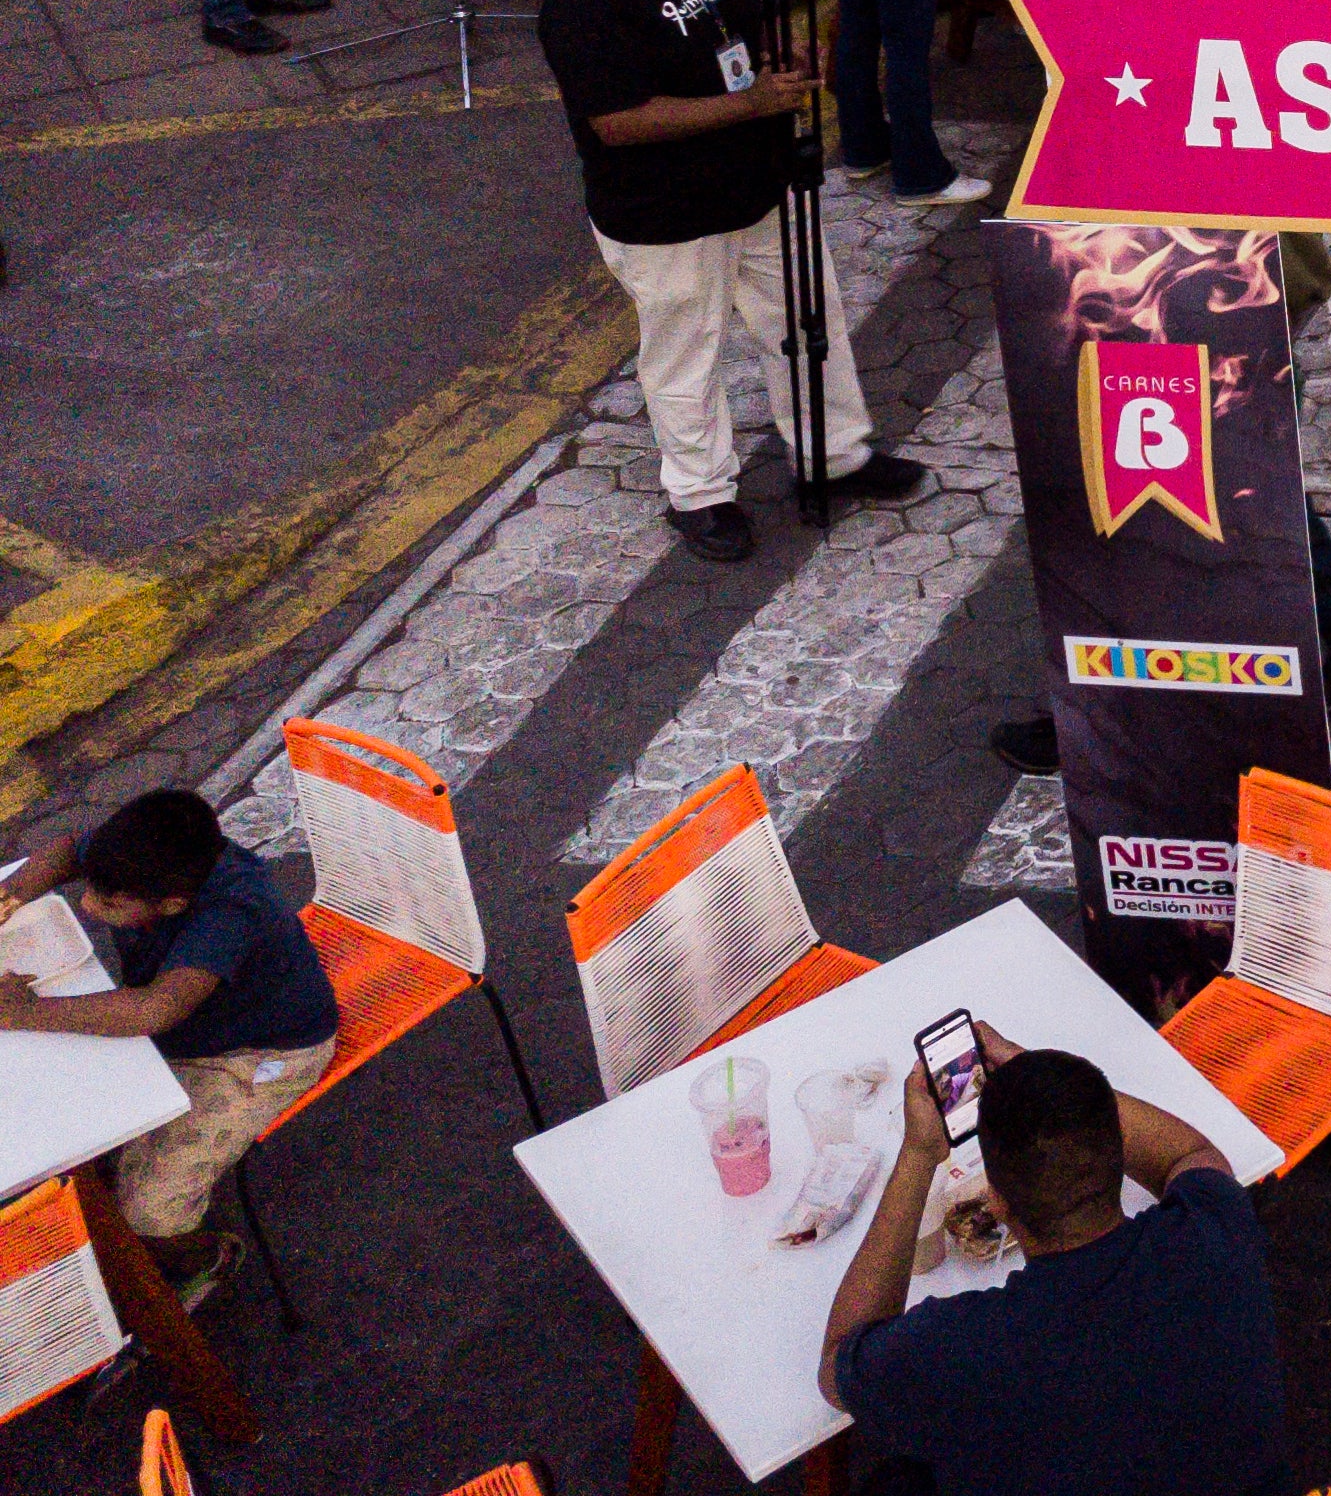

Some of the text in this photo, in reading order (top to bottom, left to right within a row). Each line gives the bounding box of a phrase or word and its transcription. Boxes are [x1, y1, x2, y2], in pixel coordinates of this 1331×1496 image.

[1103, 374, 1197, 396] CARNES
[1074, 642, 1292, 688] KIOSKO
[1105, 841, 1237, 872] NISS
[1110, 869, 1235, 896] Ranca
[1113, 897, 1190, 914] Decisión
